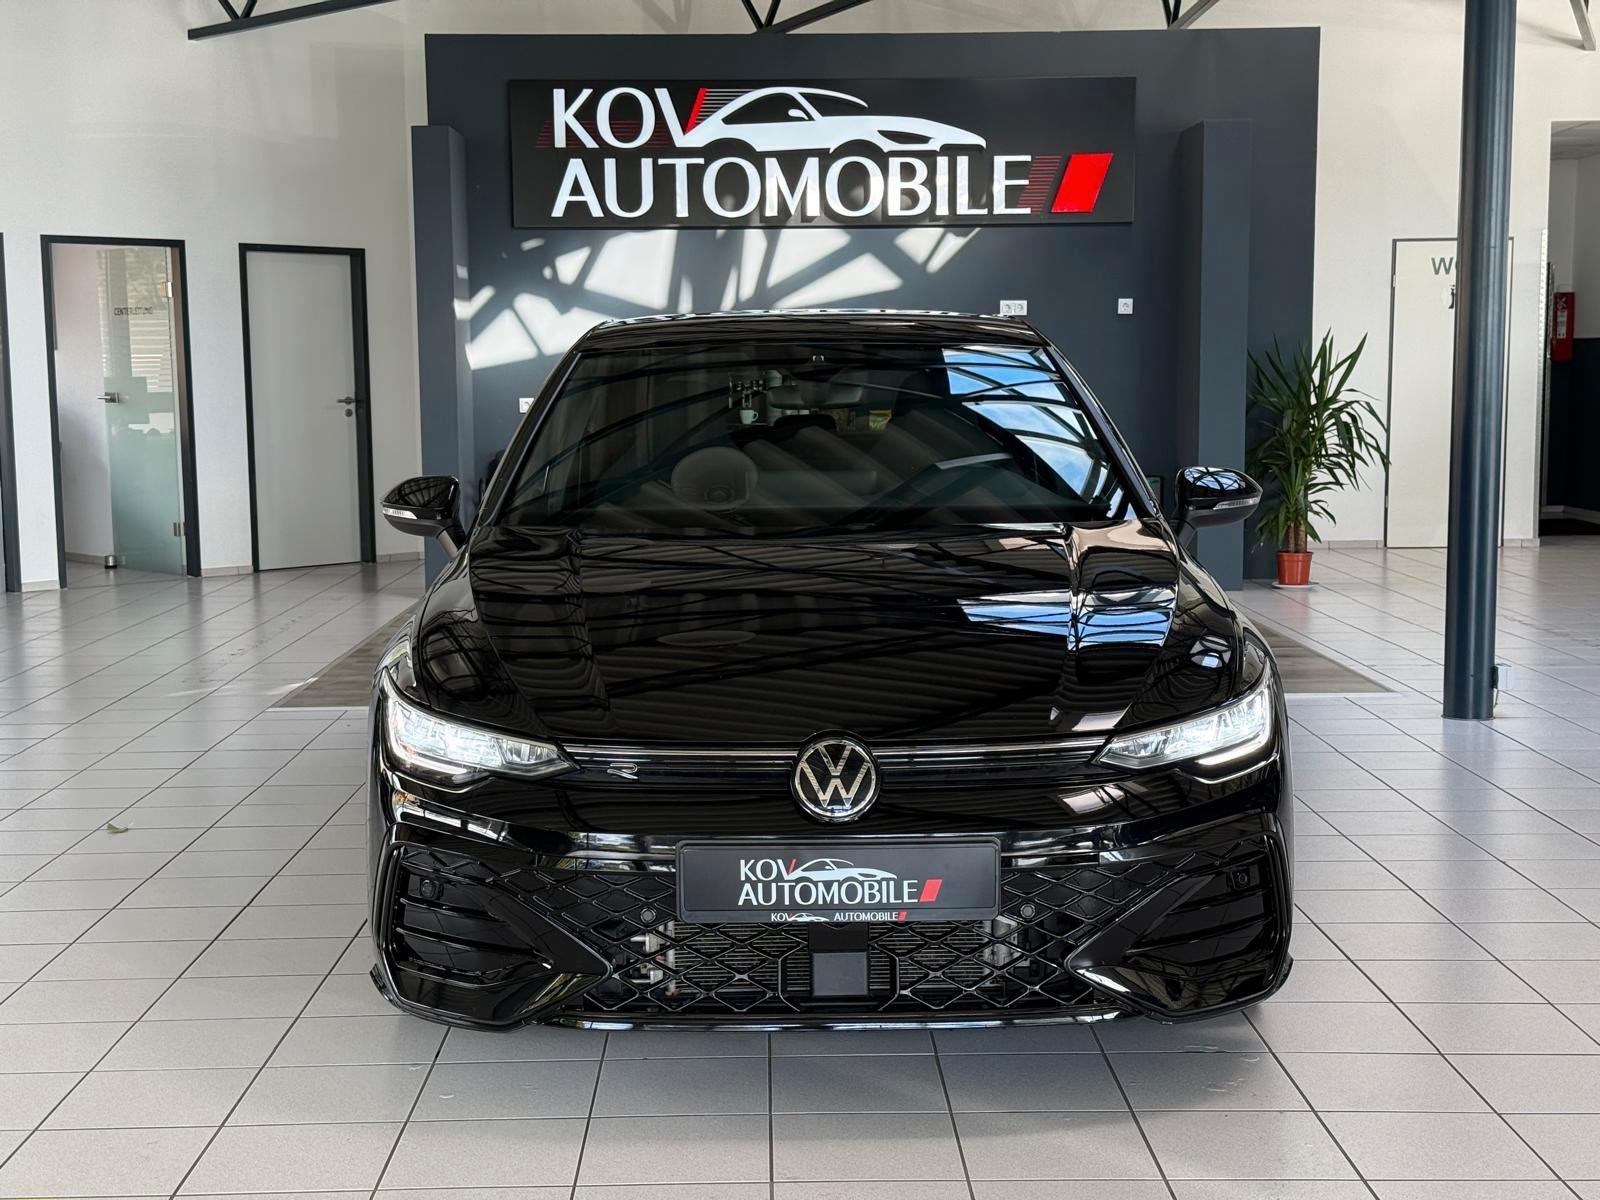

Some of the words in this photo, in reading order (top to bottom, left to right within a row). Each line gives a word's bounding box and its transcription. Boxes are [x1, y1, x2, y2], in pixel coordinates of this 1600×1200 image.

[552, 87, 708, 149] KOV
[550, 155, 1032, 218] AUTOMOBILE
[1431, 256, 1457, 275] W
[740, 858, 797, 881] KOV
[738, 880, 918, 906] AUTOMOBILE
[771, 912, 793, 921] KOV
[834, 911, 899, 921] AUTOMOBILE
